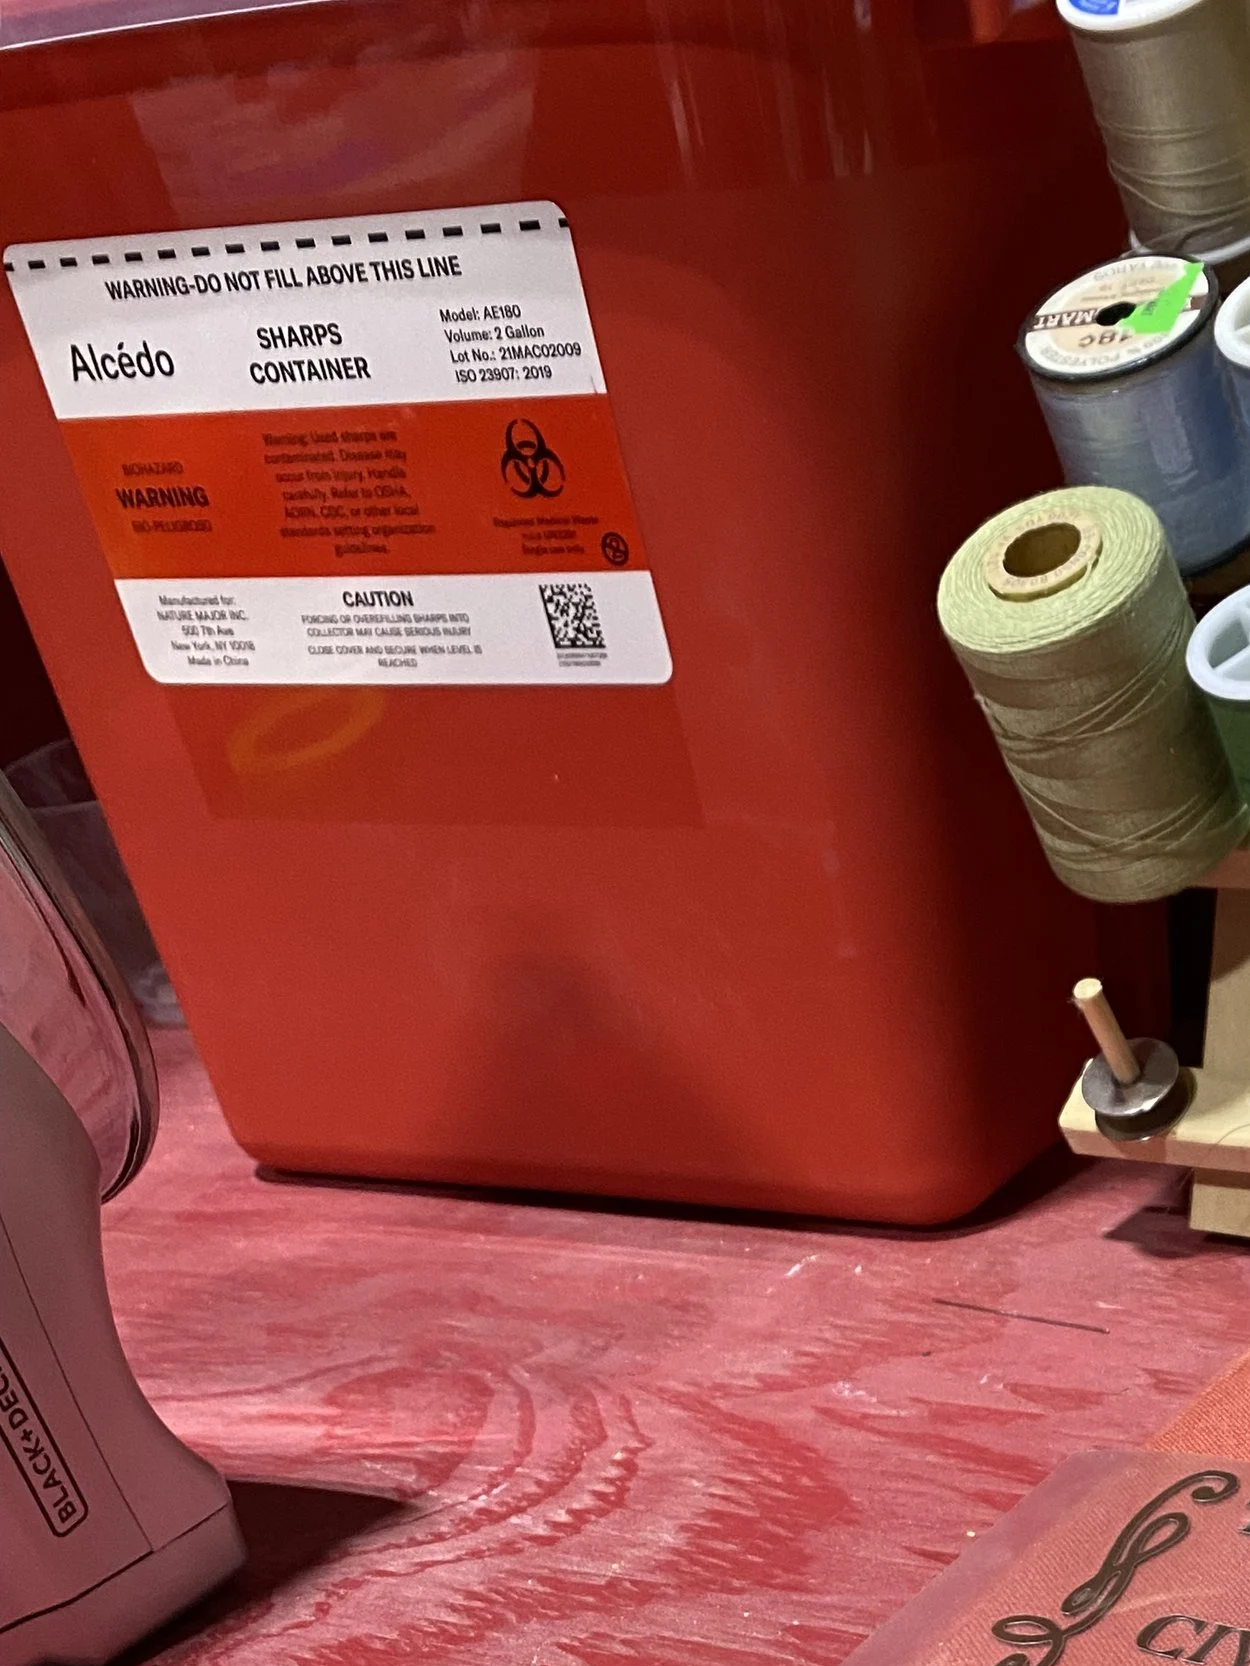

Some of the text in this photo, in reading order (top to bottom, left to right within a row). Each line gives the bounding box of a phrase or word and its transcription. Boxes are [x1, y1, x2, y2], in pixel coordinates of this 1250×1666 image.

[104, 255, 462, 301] WARNING-DO NOT FILL ABOVE THIS LINE
[439, 304, 522, 323] Model: AE180
[256, 322, 343, 350] SHARPS
[444, 324, 545, 344] Volume: 2 Gallon
[69, 340, 175, 382] Alcédo
[450, 349, 470, 363] Lot
[249, 356, 372, 385] CONTAINER
[455, 369, 477, 383] ISO
[522, 365, 553, 380] 2019
[115, 485, 210, 509] WARNING
[342, 590, 415, 608] CAUTION
[157, 610, 193, 621] NATURE
[194, 610, 228, 621] MAJOR
[301, 614, 339, 625] FORCING
[339, 614, 352, 625] OR
[413, 613, 448, 624] SHARPS
[449, 613, 470, 623] INTO
[216, 624, 235, 636] Ave
[307, 626, 472, 638] COLLECTOR MAY CAUSE SERIOUS INJURY
[170, 640, 191, 651] New
[214, 640, 228, 651] NY
[307, 645, 335, 655] CLOSE
[335, 645, 363, 655] COVER
[365, 645, 383, 655] AND
[384, 645, 417, 655] SECURE
[418, 645, 446, 655] WHEN
[446, 644, 472, 655] LEVEL
[187, 656, 212, 666] Made
[222, 655, 249, 666] China
[377, 658, 418, 668] REACHED
[0, 1364, 78, 1524] BLACK+DEC
